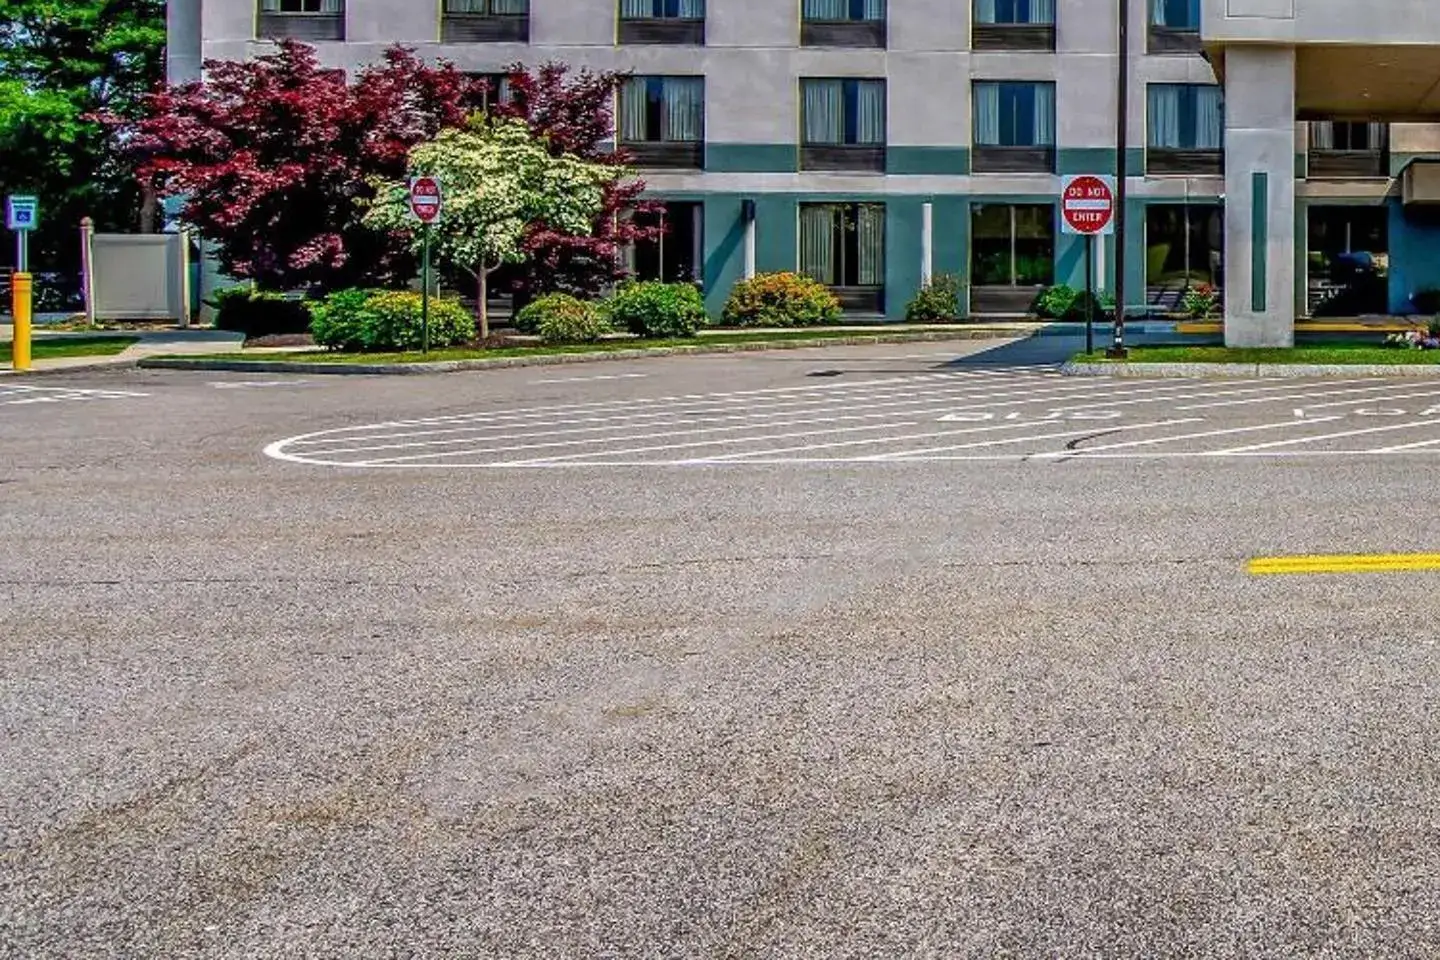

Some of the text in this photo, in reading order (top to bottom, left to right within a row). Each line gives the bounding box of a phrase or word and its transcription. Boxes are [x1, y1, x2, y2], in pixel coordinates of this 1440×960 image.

[1069, 187, 1105, 197] DO NOT
[1072, 212, 1102, 221] ENTER
